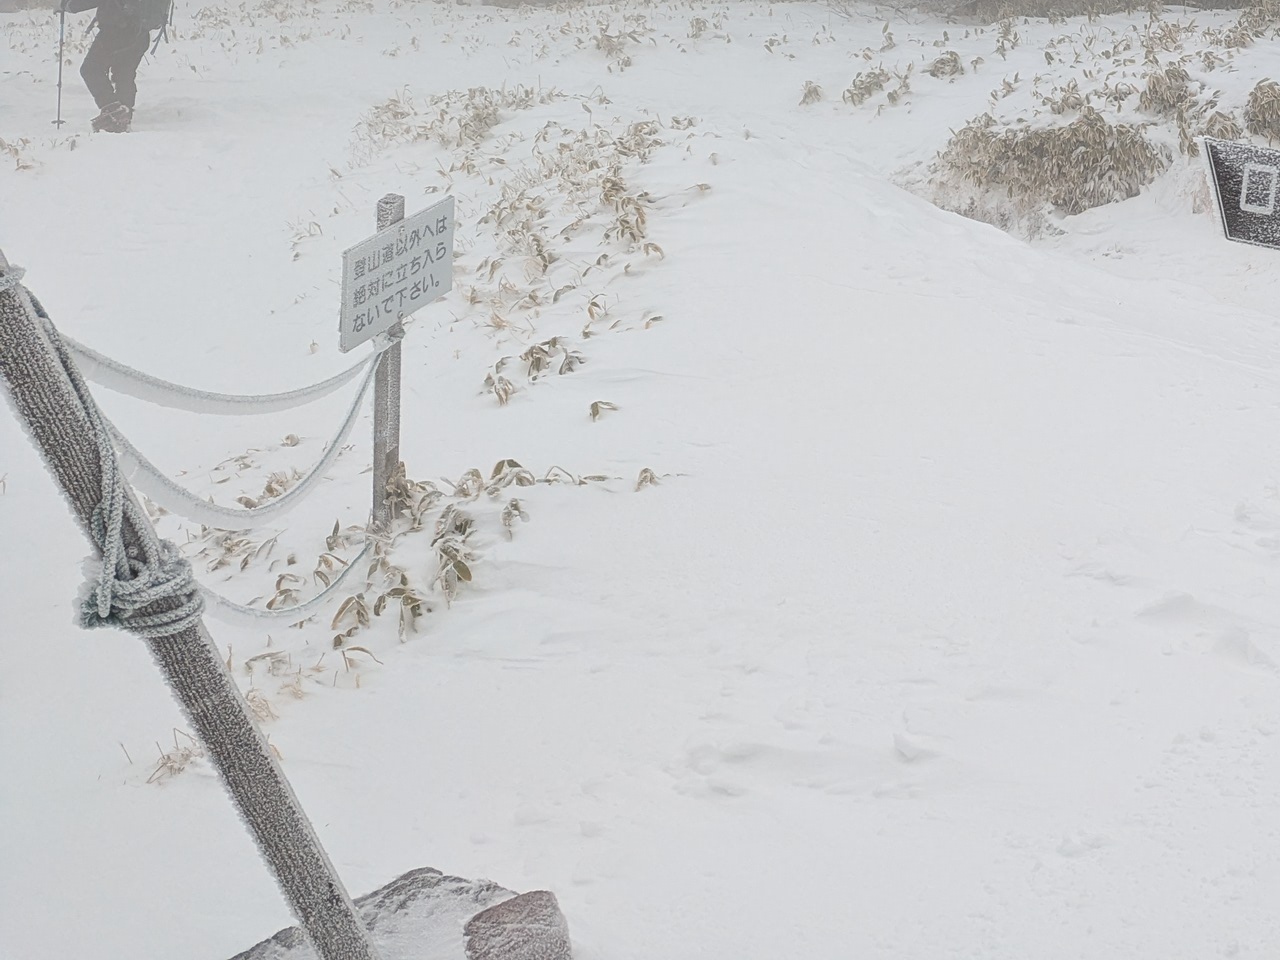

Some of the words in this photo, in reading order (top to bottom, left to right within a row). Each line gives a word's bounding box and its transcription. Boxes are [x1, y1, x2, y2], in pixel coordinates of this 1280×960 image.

[352, 241, 447, 308] 絶対に立ち入ら
[353, 214, 447, 280] 登山道以外へは
[352, 273, 440, 333] ないで下さい。
